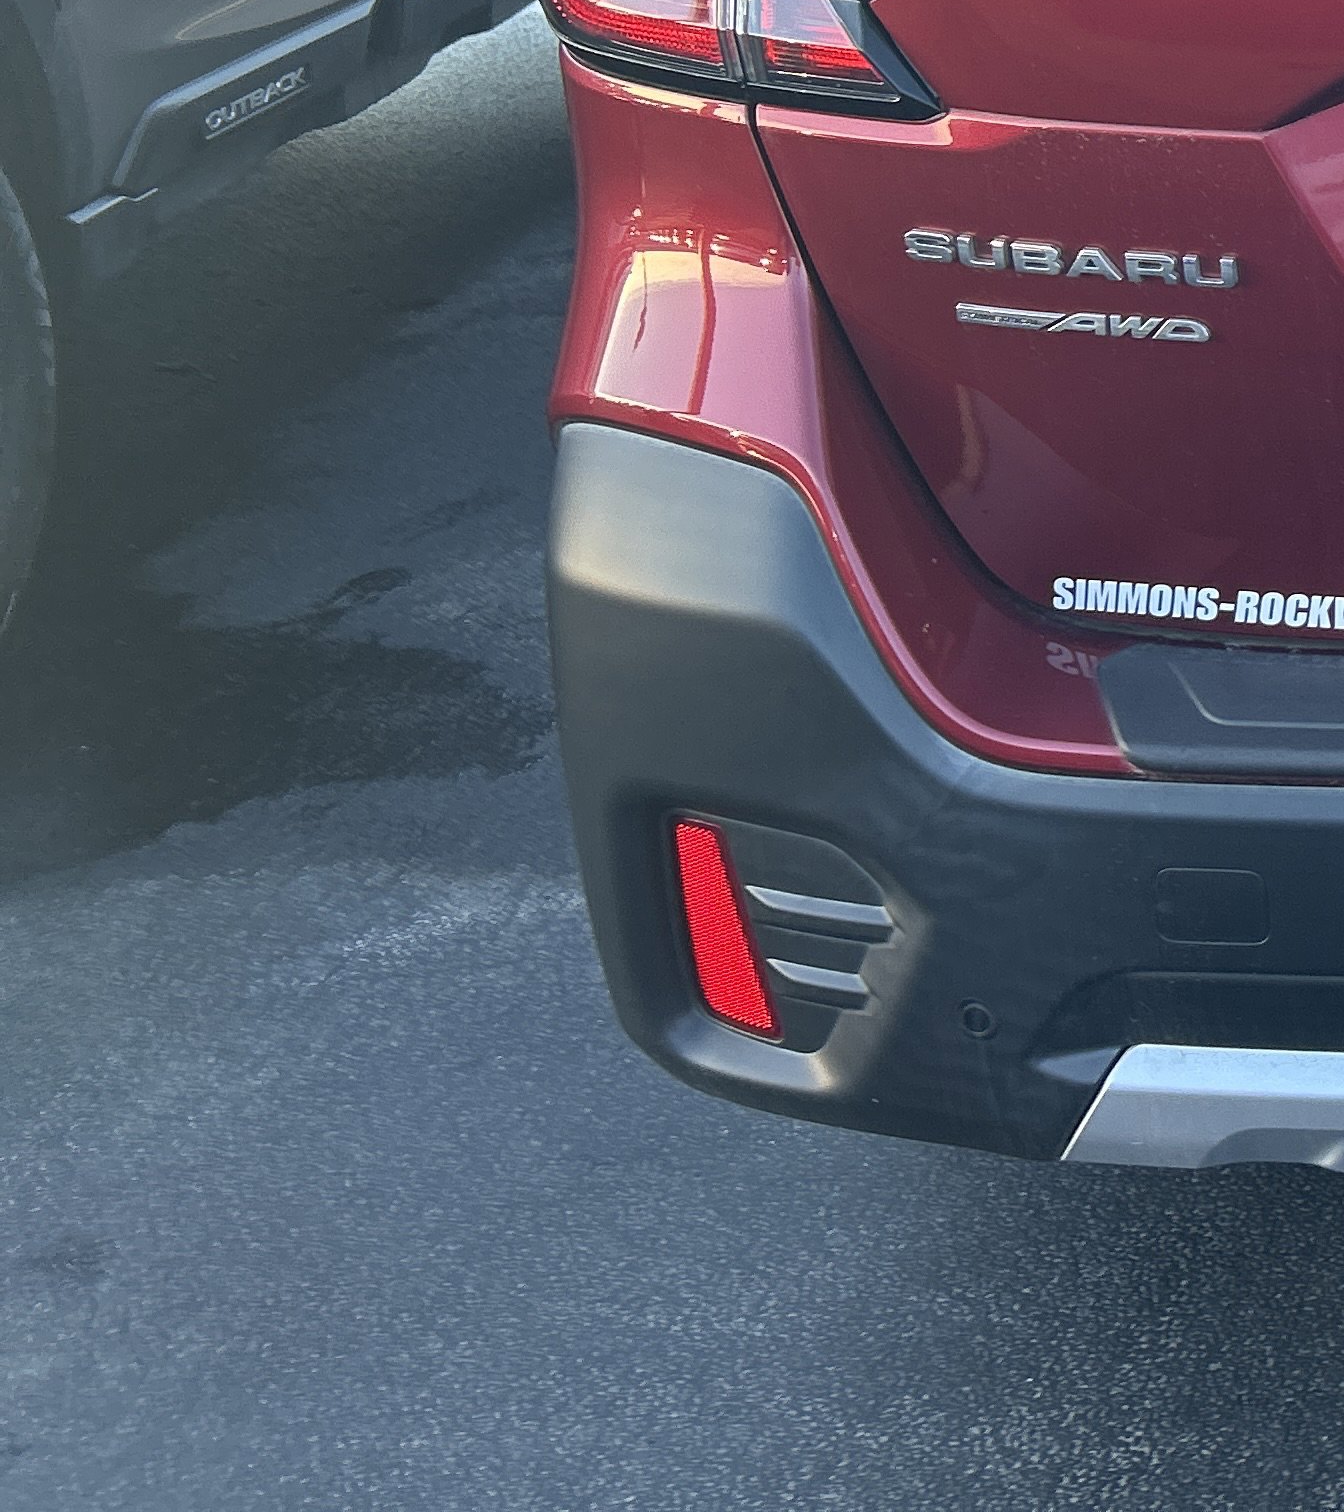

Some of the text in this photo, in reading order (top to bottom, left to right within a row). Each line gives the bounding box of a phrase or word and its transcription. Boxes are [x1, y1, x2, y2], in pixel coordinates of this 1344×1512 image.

[205, 67, 307, 130] OUTBACK
[903, 227, 1241, 288] SUBARU
[1047, 312, 1212, 343] AWD
